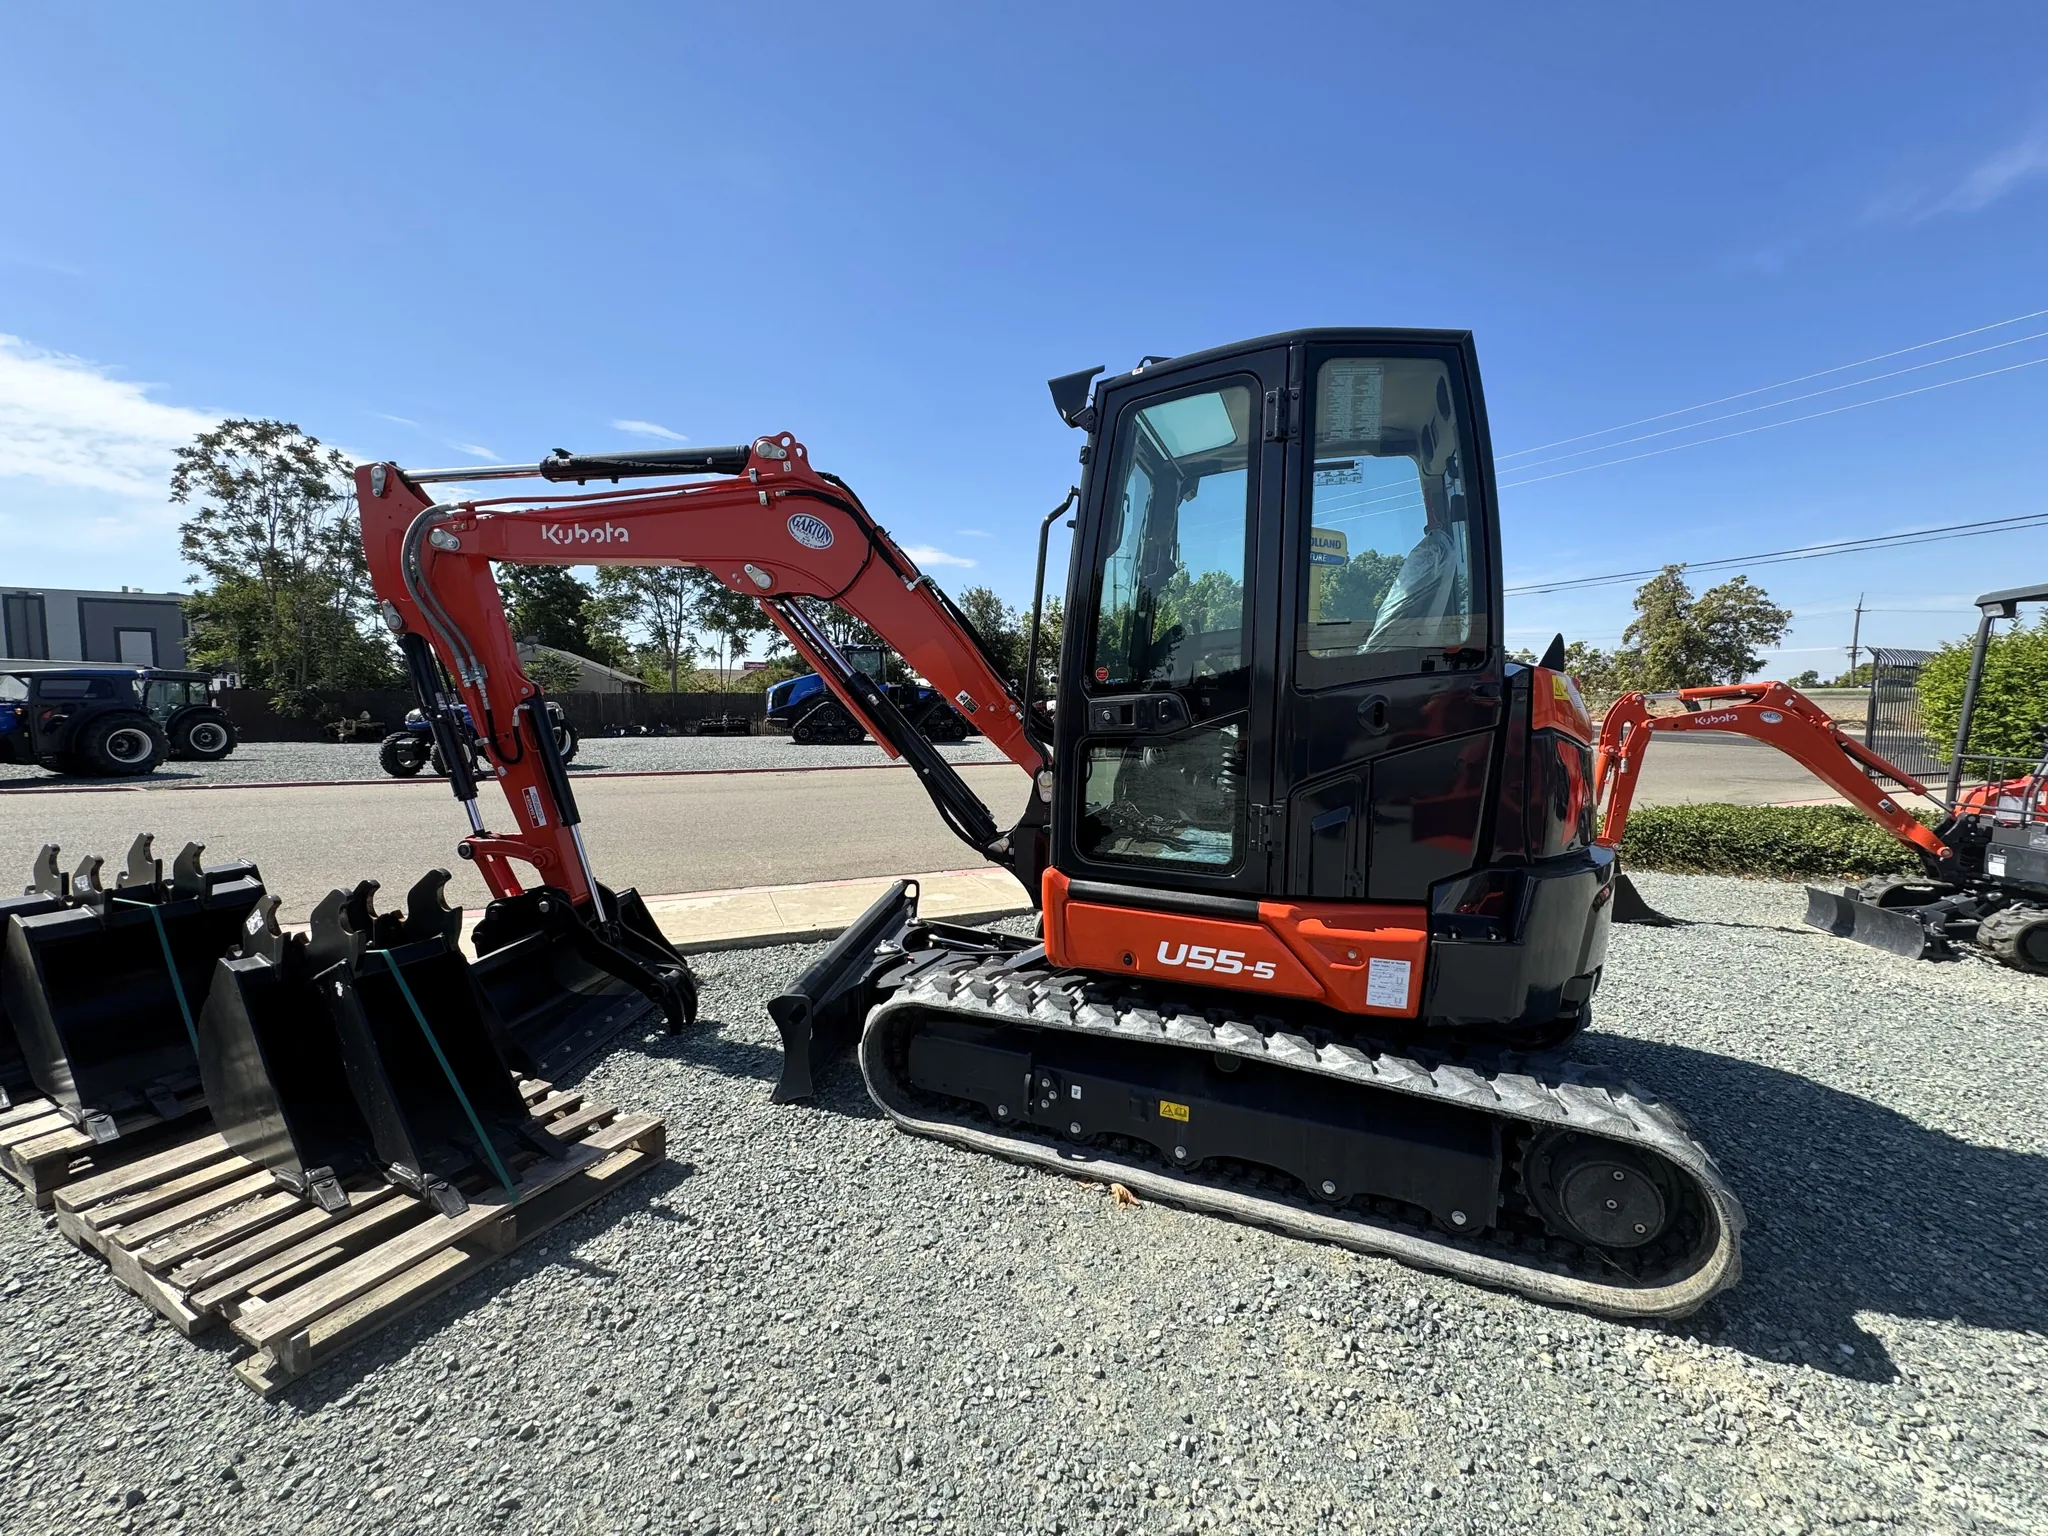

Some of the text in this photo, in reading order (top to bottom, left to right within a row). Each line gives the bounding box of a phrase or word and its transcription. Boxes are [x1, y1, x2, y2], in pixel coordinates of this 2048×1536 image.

[541, 522, 629, 545] Kubota
[792, 516, 830, 543] GARTON
[1694, 713, 1738, 725] Kubota
[1156, 940, 1277, 979] U55-5
